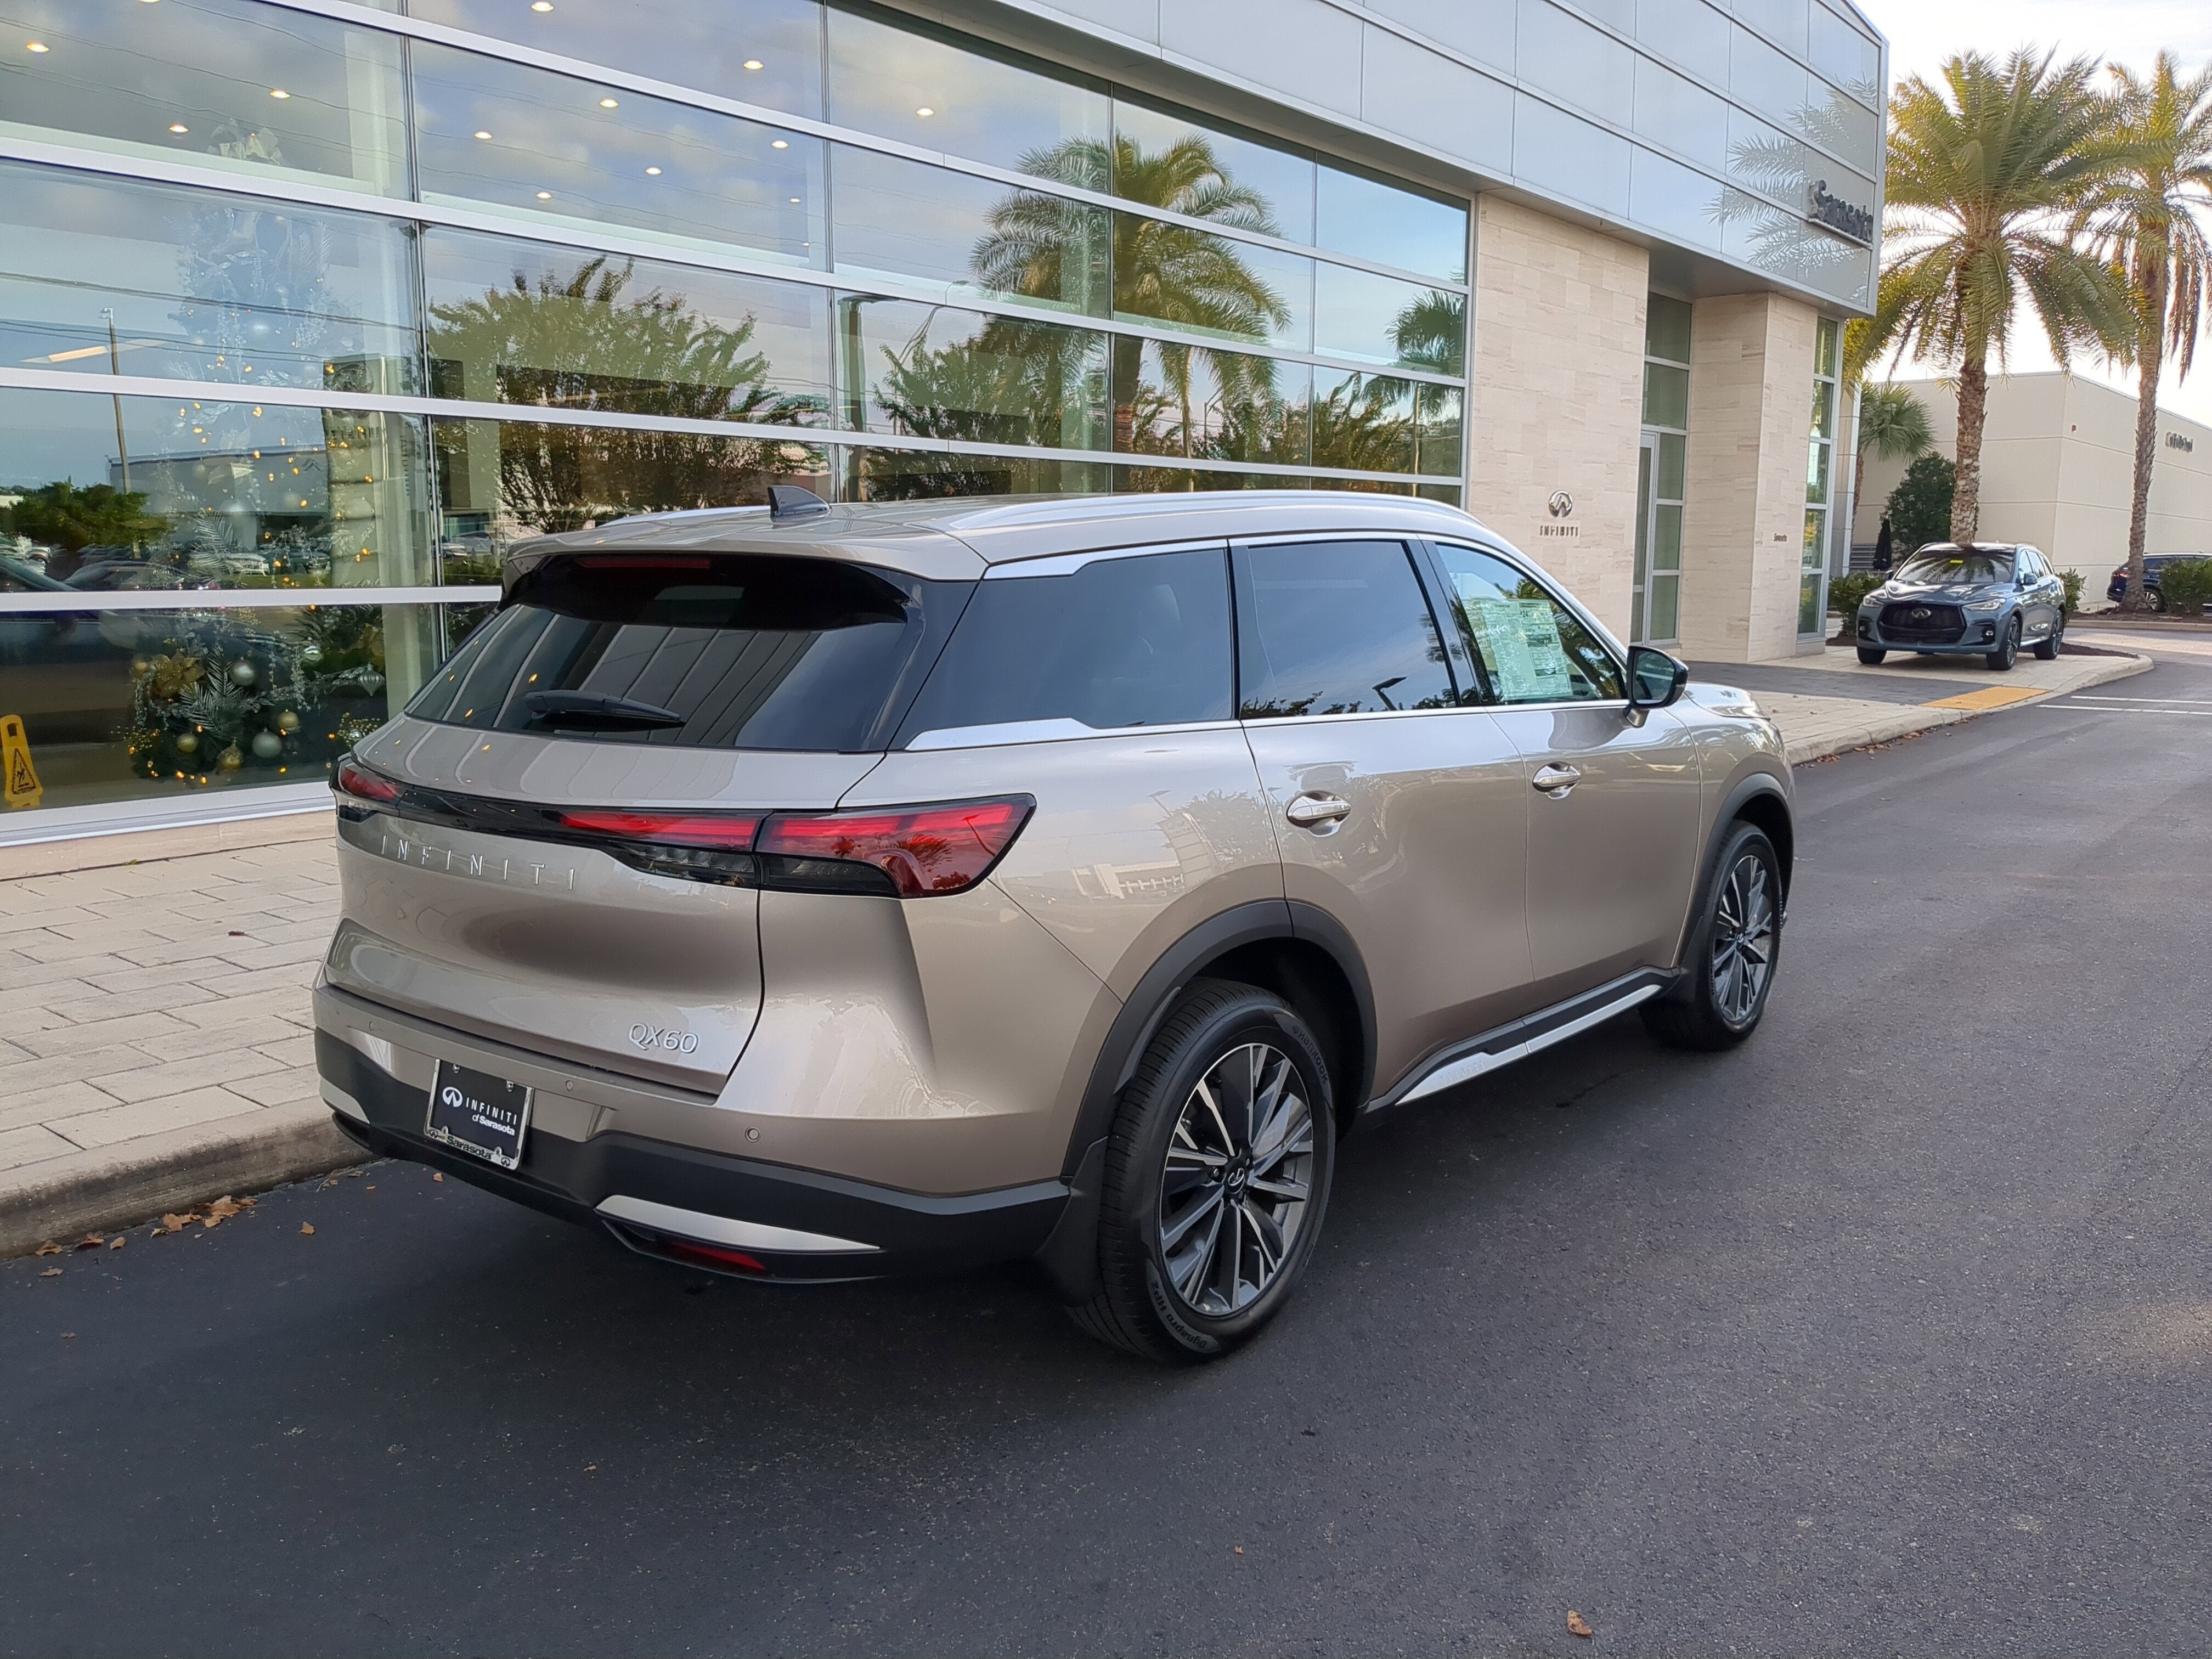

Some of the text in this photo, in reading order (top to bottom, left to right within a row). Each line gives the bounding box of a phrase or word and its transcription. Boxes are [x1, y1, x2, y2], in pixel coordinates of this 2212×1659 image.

[1809, 179, 1874, 242] Sarasota
[1539, 525, 1578, 537] INFINITI
[381, 834, 575, 890] INFINITI
[629, 1023, 699, 1054] QX60
[466, 1097, 517, 1125] INFINITI
[472, 1114, 515, 1136] of Sarasota
[447, 1135, 492, 1160] Sarasota
